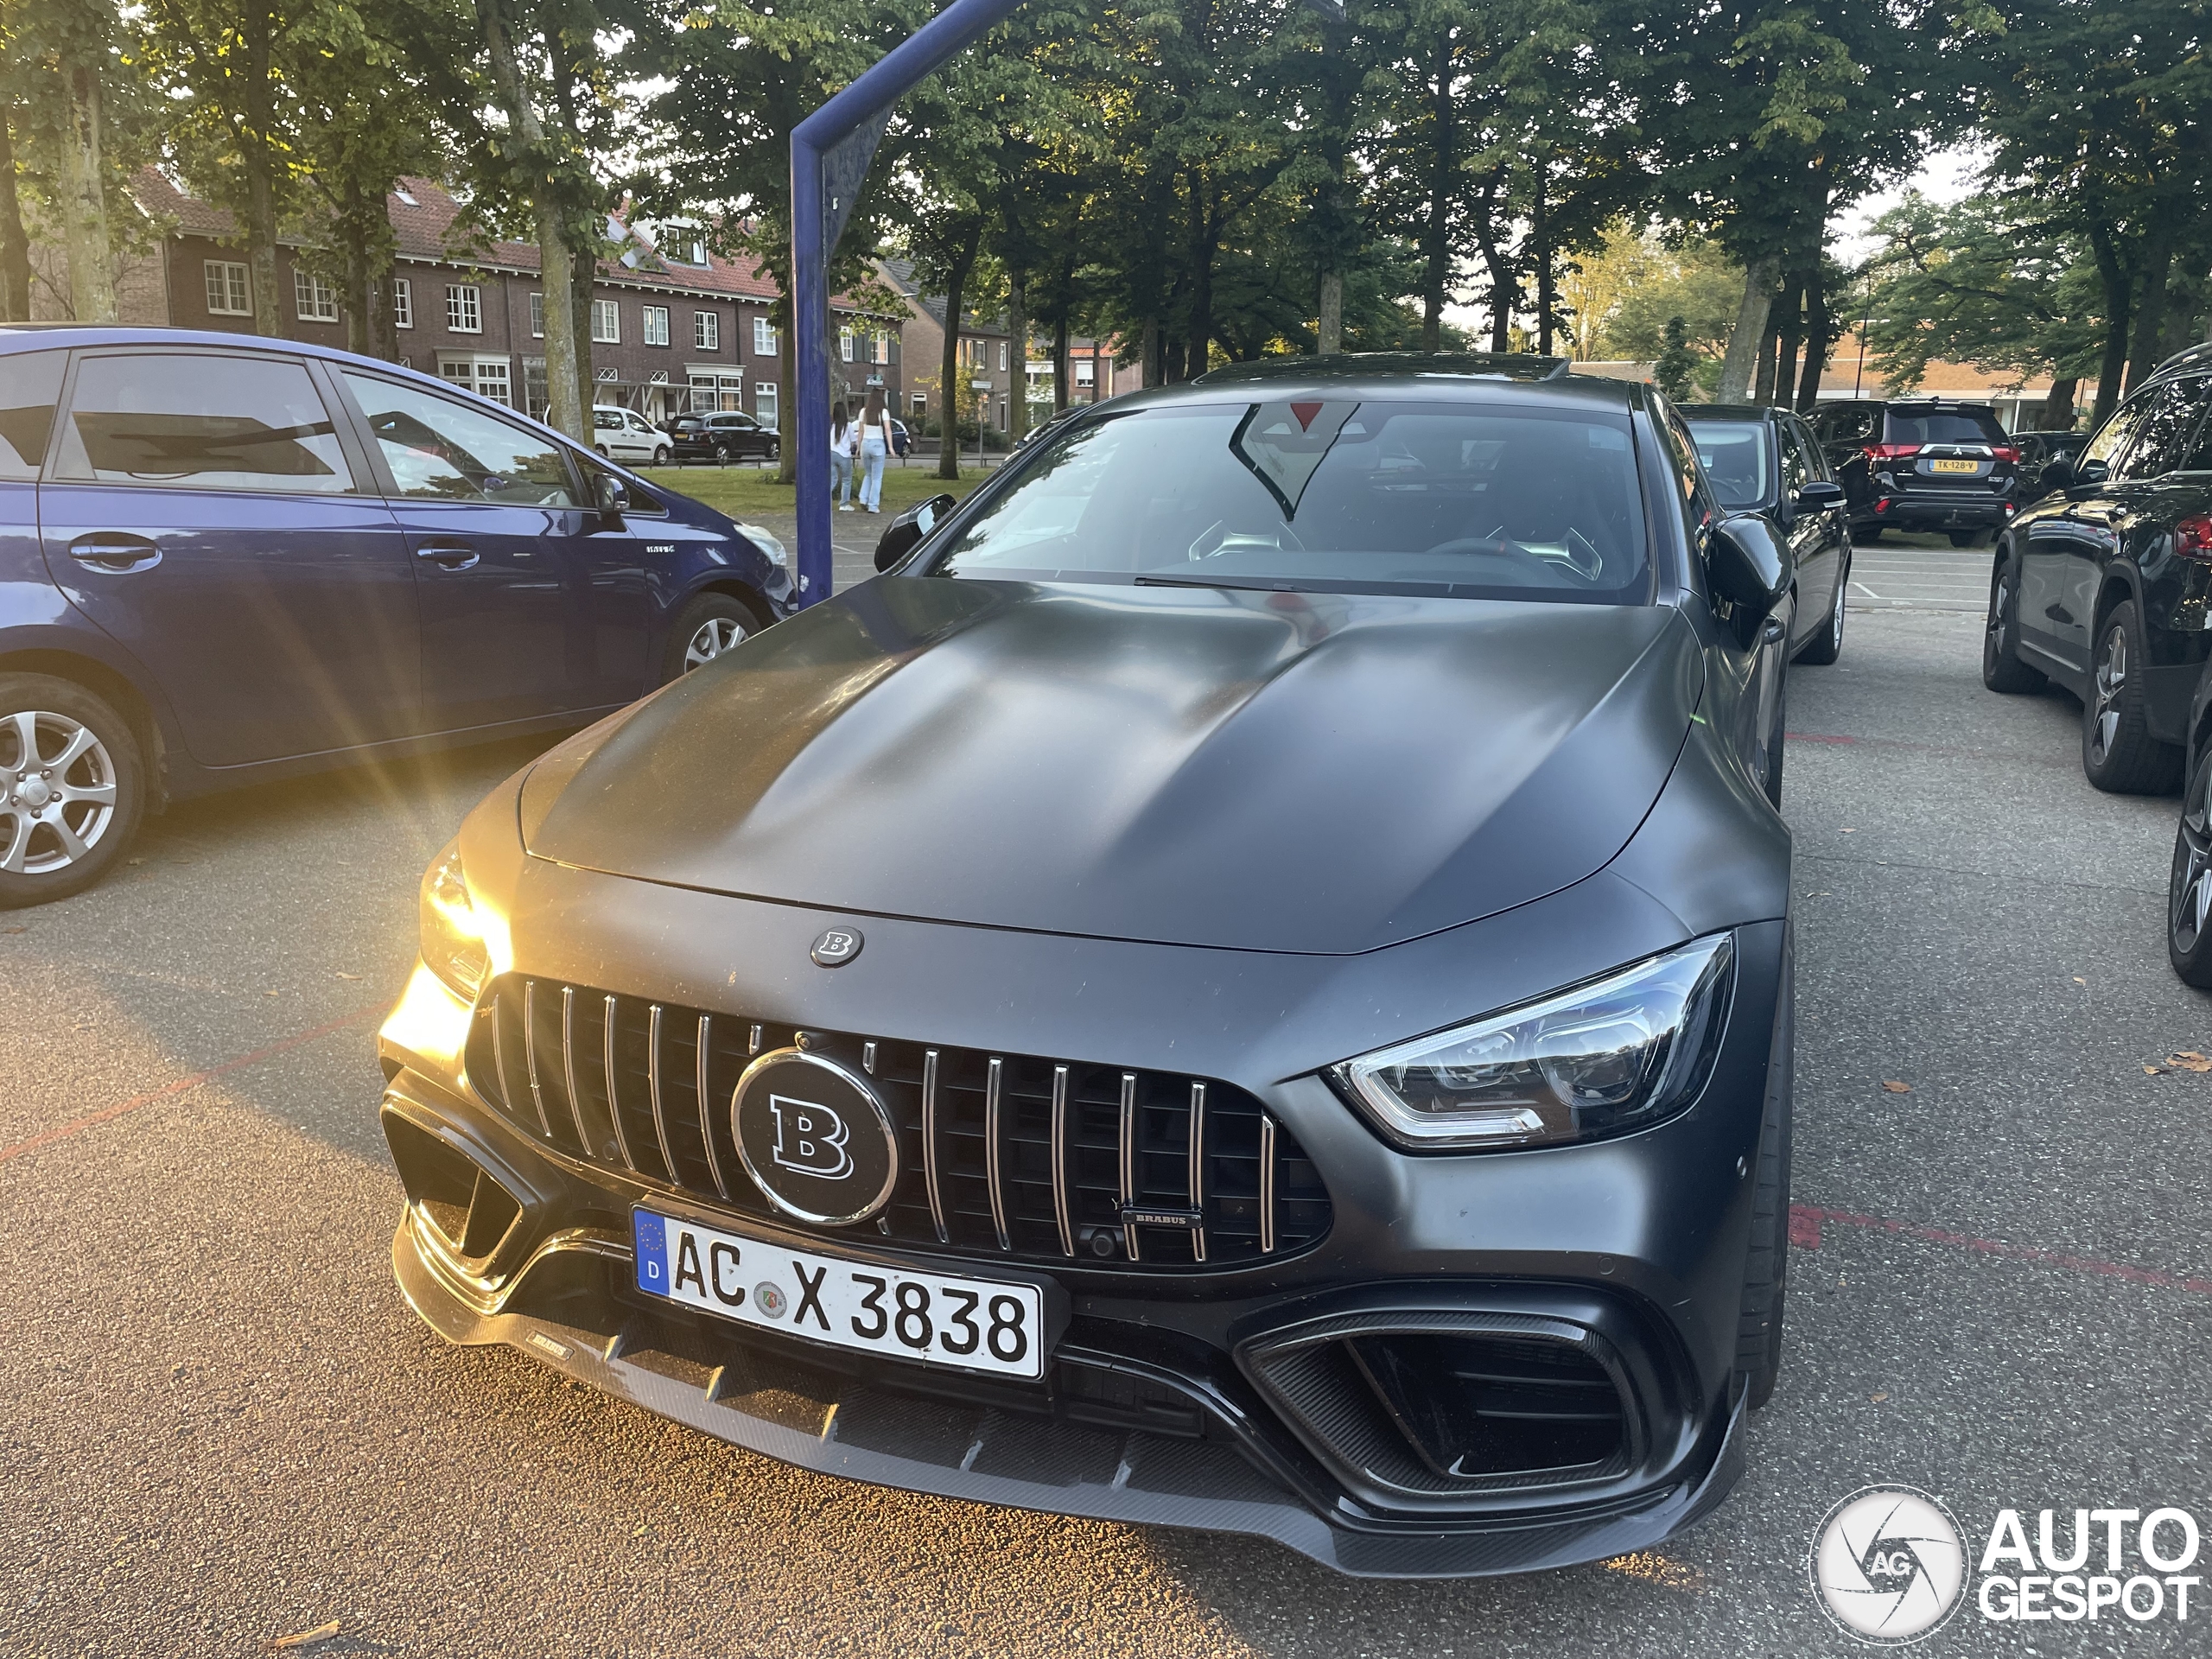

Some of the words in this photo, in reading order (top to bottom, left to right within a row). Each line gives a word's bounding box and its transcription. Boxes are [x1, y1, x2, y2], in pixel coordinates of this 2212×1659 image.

[1937, 461, 1974, 469] TK-128-V
[817, 931, 854, 957] B
[769, 1093, 855, 1180] B
[1135, 1214, 1186, 1224] BRABUS
[647, 1260, 660, 1280] D
[675, 1230, 746, 1307] AC
[791, 1260, 831, 1332] X
[850, 1273, 1028, 1363] 3838
[531, 1333, 567, 1357] BRABUS
